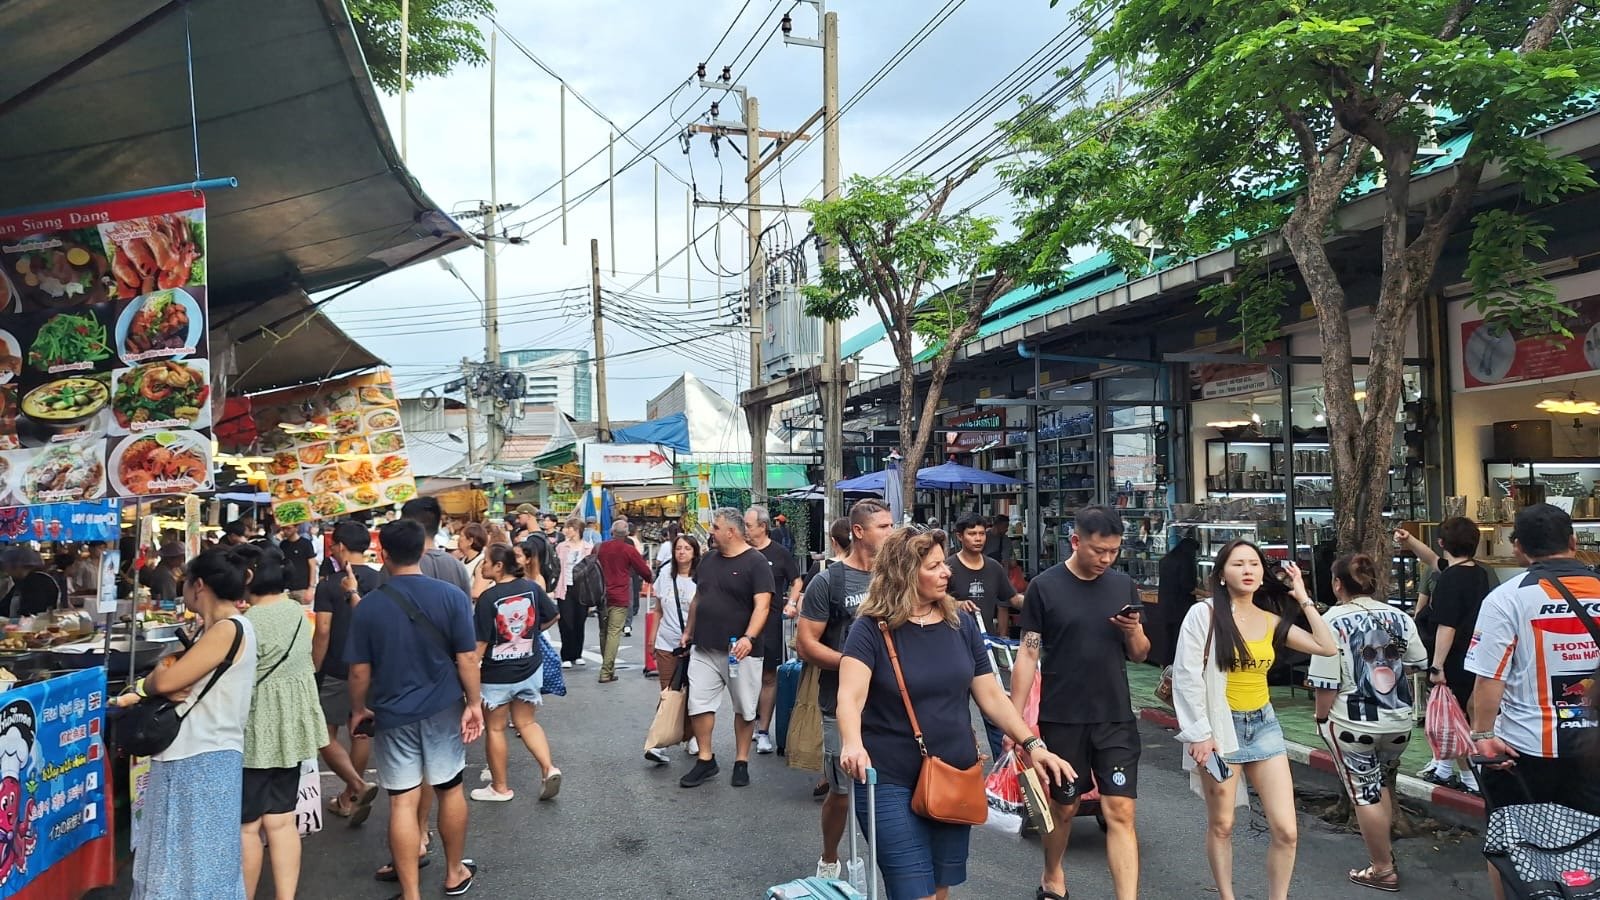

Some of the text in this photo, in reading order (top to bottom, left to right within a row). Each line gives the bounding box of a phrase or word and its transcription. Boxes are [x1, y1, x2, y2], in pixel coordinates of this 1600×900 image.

[22, 218, 63, 231] Siang
[69, 211, 110, 224] Dang
[1561, 653, 1582, 661] Satu
